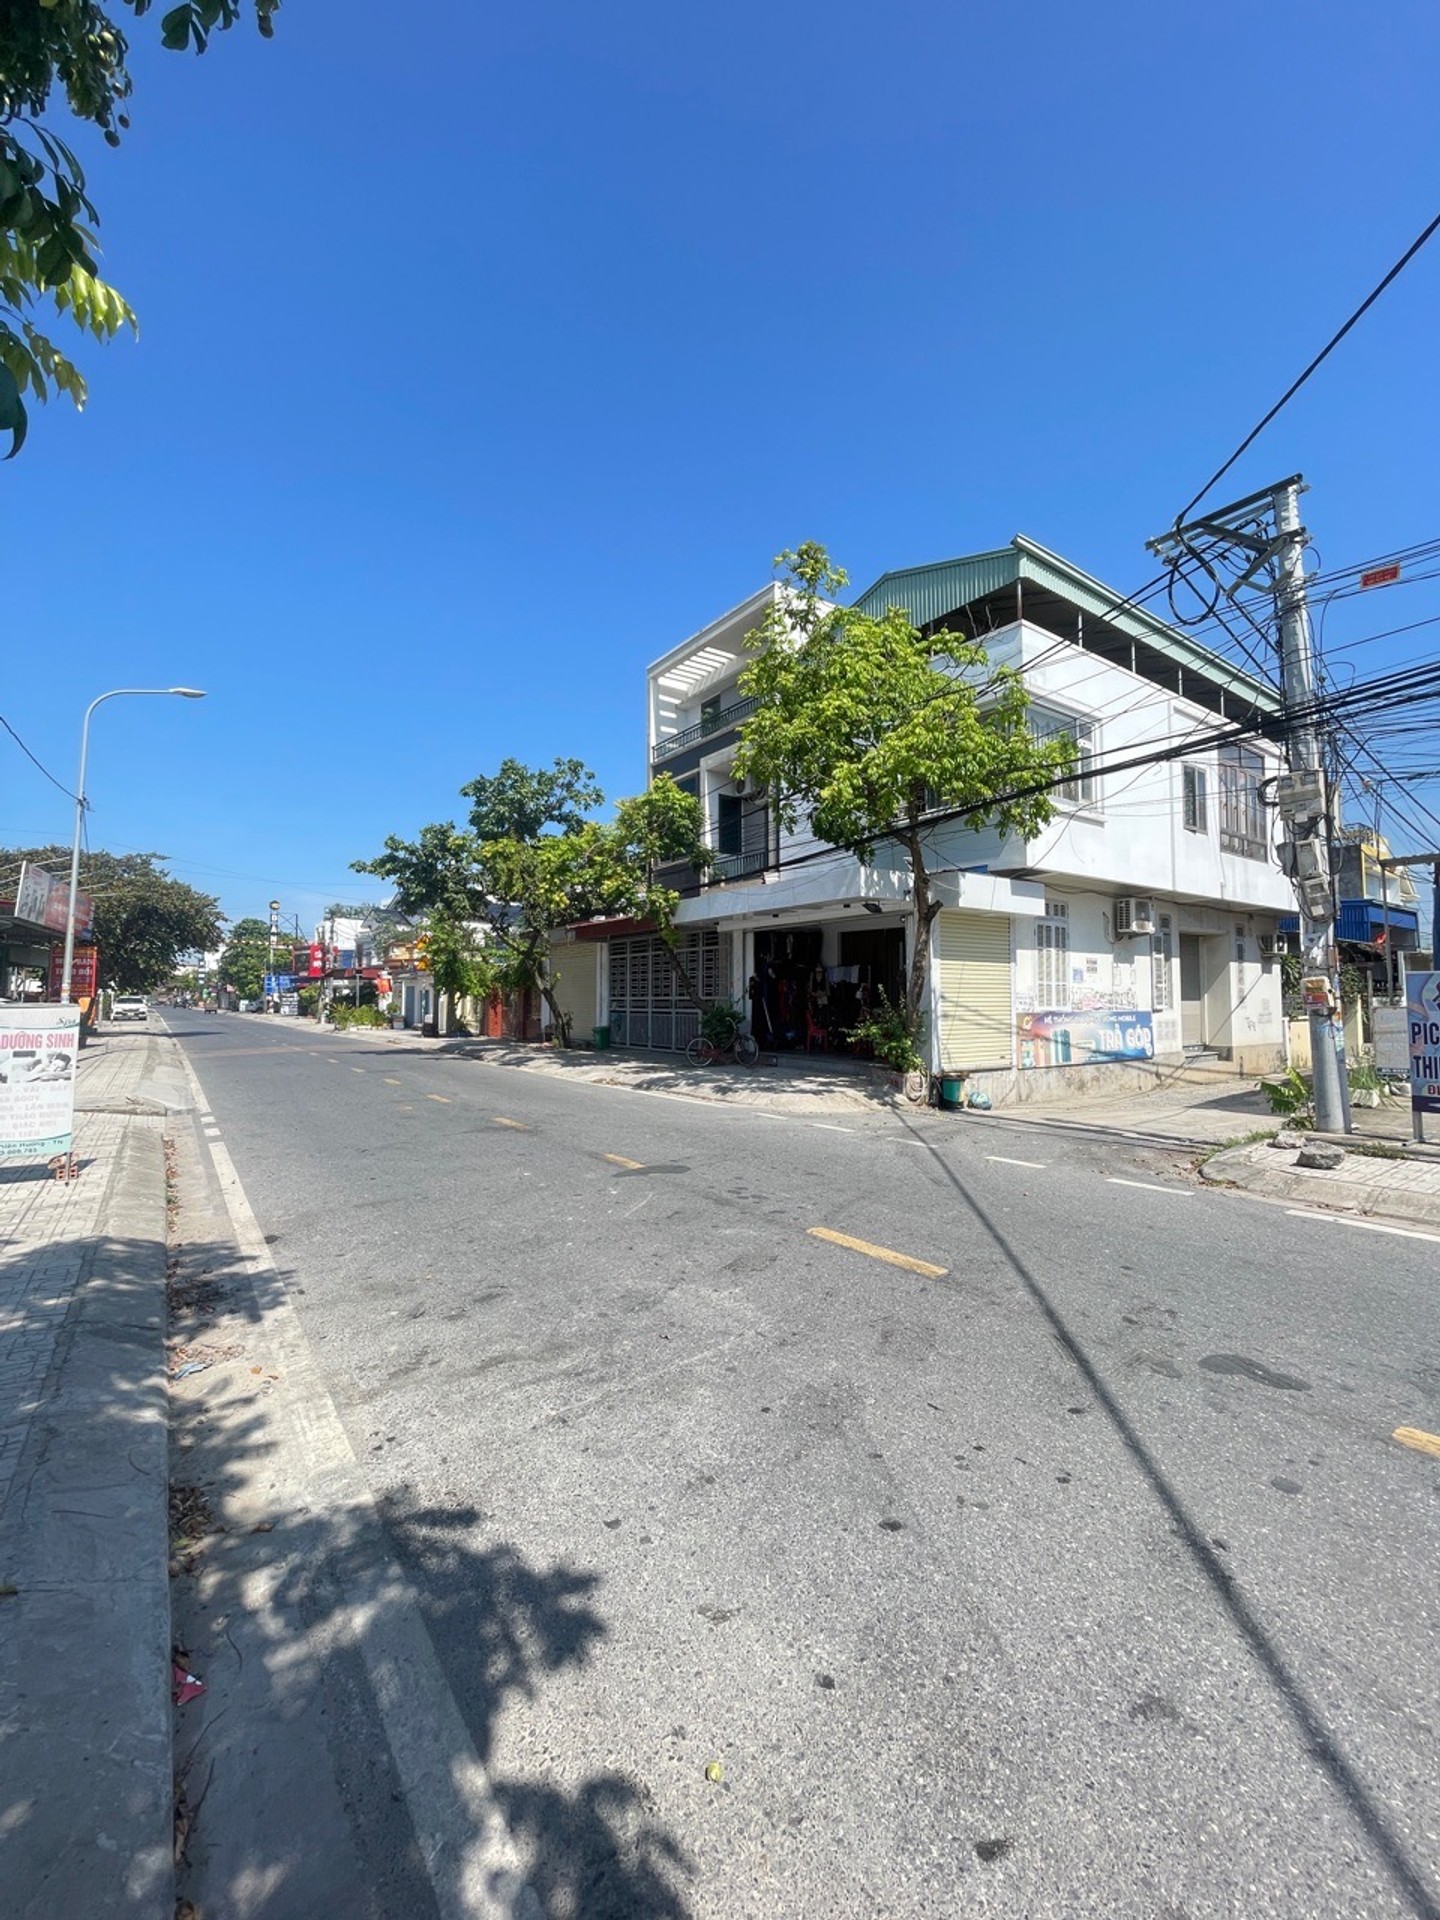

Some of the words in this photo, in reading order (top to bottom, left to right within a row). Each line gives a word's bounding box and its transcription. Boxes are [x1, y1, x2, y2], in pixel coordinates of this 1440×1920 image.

[1, 1031, 43, 1050] DƯỠNG
[46, 1033, 75, 1049] SINH
[1099, 1023, 1123, 1051] TRẢ
[1411, 1022, 1440, 1045] PIC
